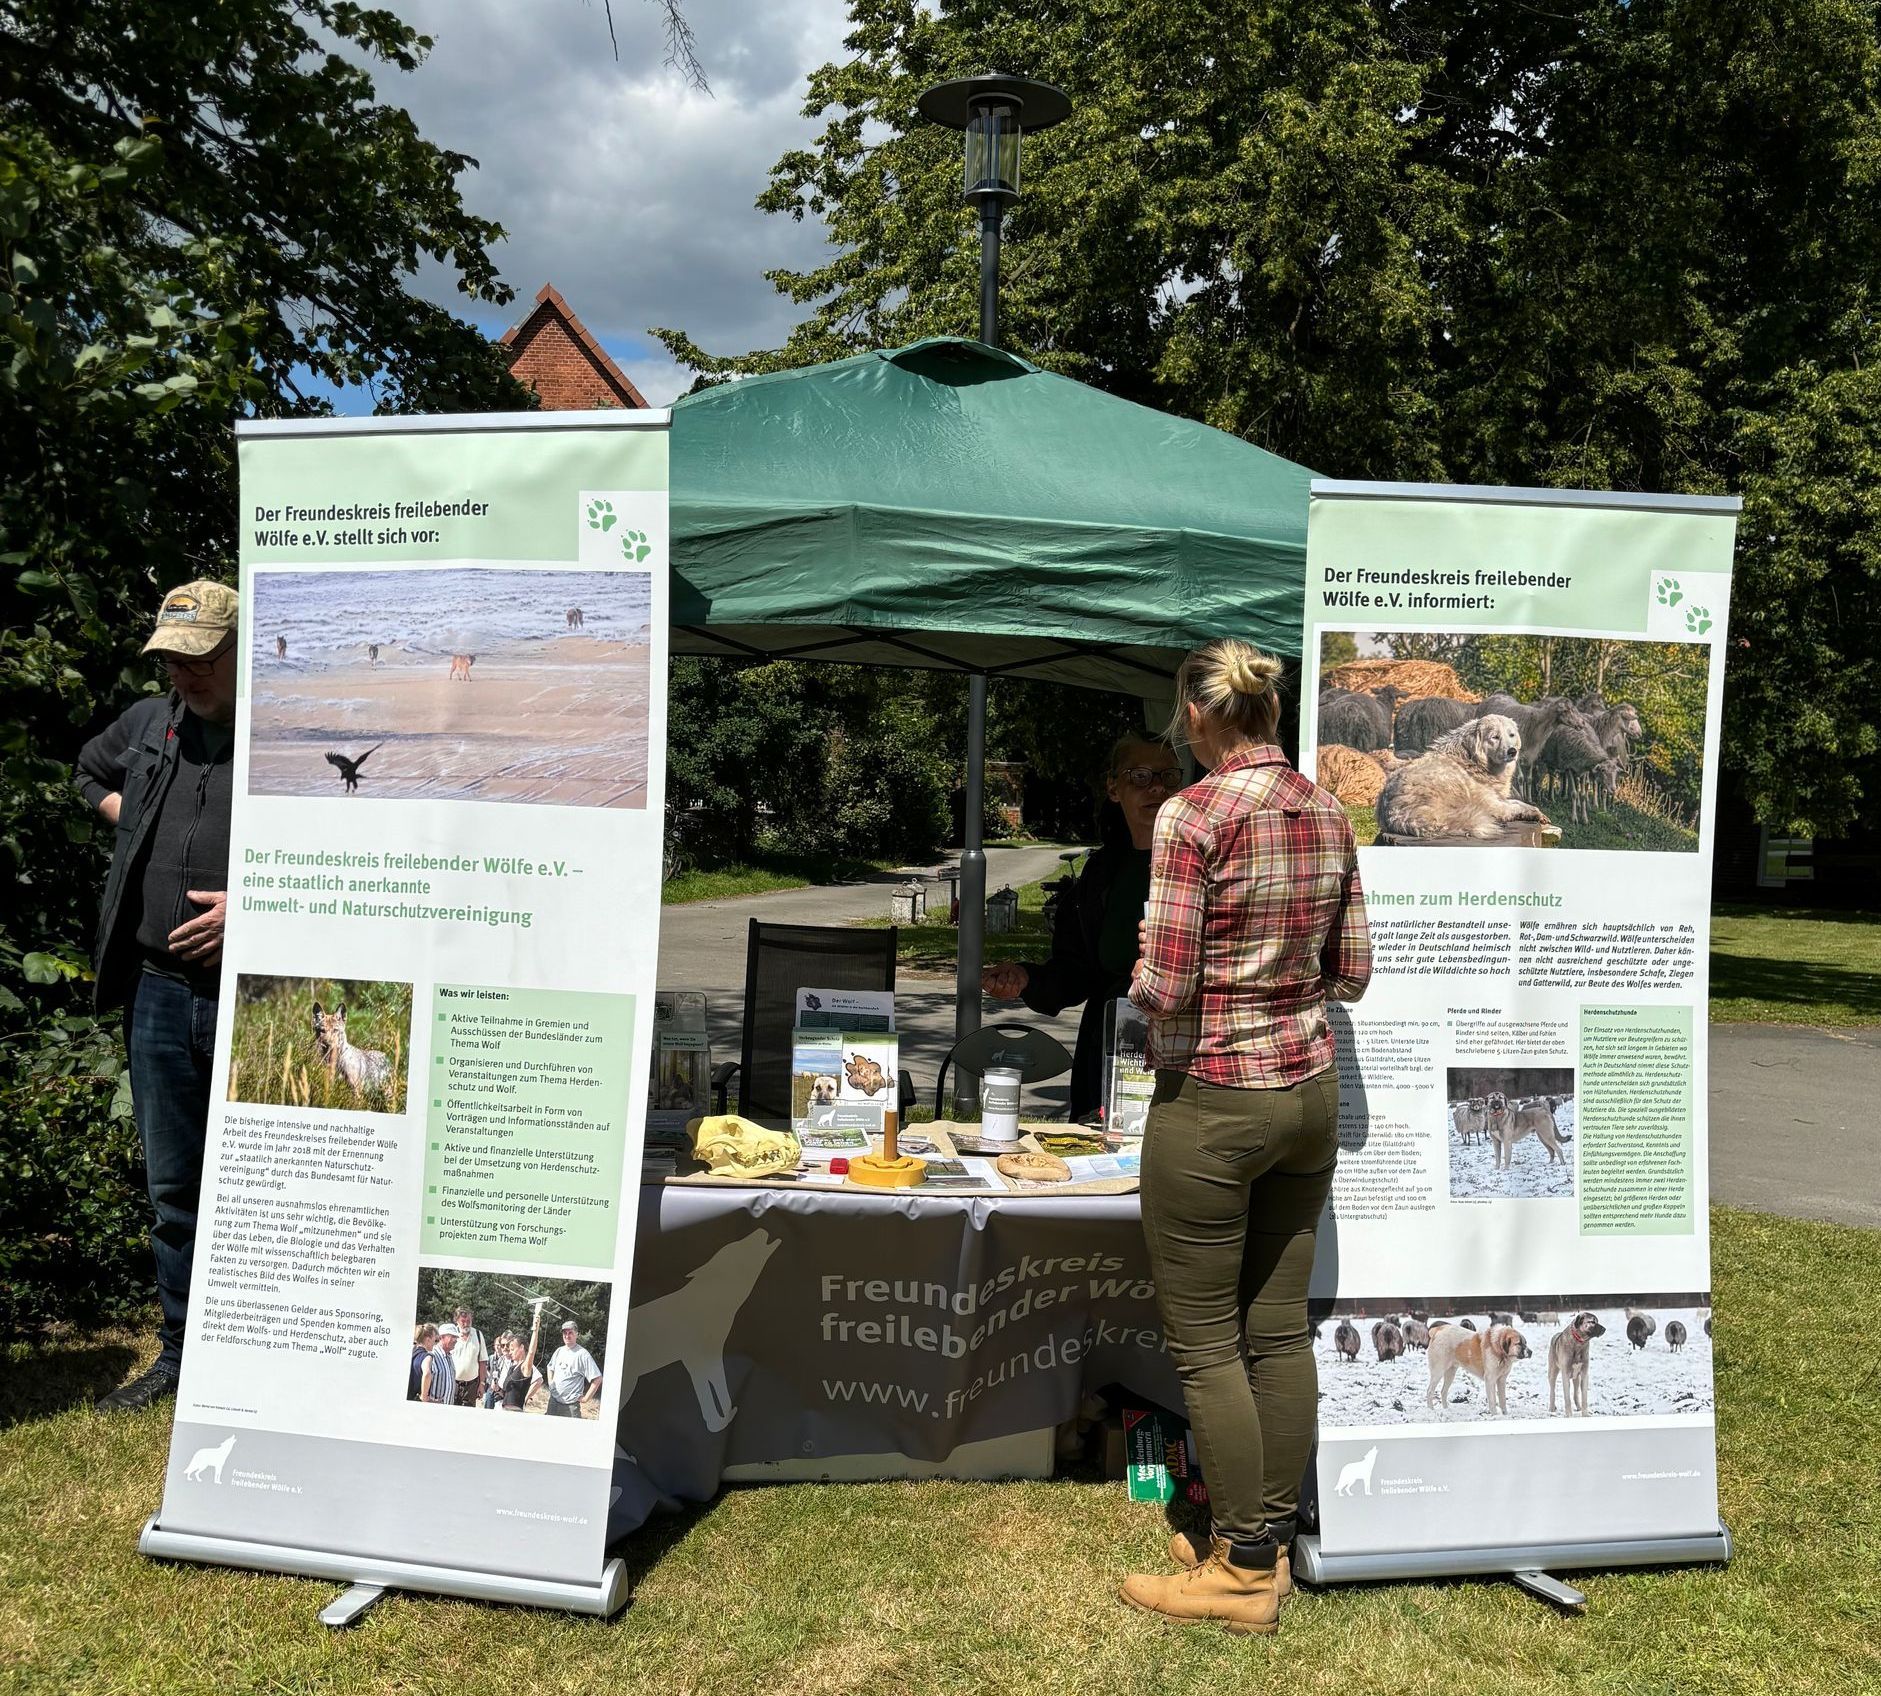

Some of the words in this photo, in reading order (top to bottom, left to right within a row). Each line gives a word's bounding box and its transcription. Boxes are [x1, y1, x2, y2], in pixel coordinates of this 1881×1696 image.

[255, 506, 281, 521] Der
[285, 504, 390, 520] Freundeskreis
[394, 500, 489, 518] freilebender
[254, 530, 298, 546] Wölfe
[302, 530, 329, 545] e.V.
[333, 528, 373, 545] stellt
[376, 527, 406, 544] sich
[410, 530, 439, 542] vor:
[1324, 567, 1352, 582] Der
[1356, 568, 1470, 584] Freundeskreis
[1474, 570, 1571, 587] freilebender
[1322, 591, 1370, 606] Wölfe
[1373, 592, 1402, 607] e.V.
[1408, 592, 1494, 608] informiert:
[244, 848, 271, 863] Der
[274, 850, 379, 867] Freundeskreis
[383, 853, 479, 871] freilebender
[483, 857, 533, 874] Wölfe
[537, 861, 568, 876] e.V.
[242, 872, 274, 887] eine
[278, 874, 343, 890] staatlich
[348, 878, 430, 893] anerkannte
[1364, 891, 1415, 906] ahmen
[1419, 894, 1452, 905] zum
[1458, 891, 1562, 906] Herdenschutz
[242, 896, 304, 912] Umwelt-
[308, 899, 337, 914] und
[342, 901, 533, 926] Naturschutzvereinigung
[1366, 919, 1389, 930] einst
[1390, 920, 1436, 928] natürlicher
[1436, 920, 1485, 928] Bestandteil
[1519, 920, 1540, 930] Wölfe
[1543, 922, 1577, 930] ernähren
[1581, 922, 1598, 930] sich
[1602, 923, 1655, 932] hauptsächlich
[1678, 924, 1694, 933] Reh,
[1378, 931, 1394, 941] galt
[1395, 931, 1418, 941] lange
[1419, 931, 1436, 940] Zeit
[1436, 932, 1449, 940] als
[1450, 932, 1511, 941] ausgestorben.
[1378, 943, 1406, 951] wieder
[1407, 943, 1416, 951] in
[1418, 943, 1470, 951] Deutschland
[1471, 943, 1511, 951] heimisch
[1394, 954, 1414, 962] sehr
[1415, 955, 1435, 964] gute
[1438, 955, 1510, 964] Lebensbedingun-
[1518, 978, 1532, 986] und
[1532, 978, 1572, 987] Gatterwild,
[1587, 979, 1610, 987] Beute
[1610, 979, 1625, 987] des
[1626, 980, 1651, 989] Wolfes
[1653, 978, 1682, 988] werden.
[439, 988, 458, 997] Was
[460, 989, 475, 998] wir
[476, 990, 509, 1000] leisten:
[450, 1013, 478, 1023] Aktive
[480, 1015, 523, 1026] Teilnahme
[525, 1017, 533, 1026] in
[535, 1018, 570, 1028] Gremien
[572, 1021, 589, 1030] und
[450, 1026, 506, 1037] Ausschüssen
[508, 1029, 523, 1038] der
[524, 1030, 583, 1041] Bundesländer
[584, 1035, 602, 1043] zum
[450, 1038, 479, 1048] Thema
[481, 1040, 501, 1049] Wolf
[449, 1057, 503, 1067] Organisieren
[505, 1060, 522, 1069] und
[523, 1061, 575, 1072] Durchführen
[448, 1069, 518, 1082] Veranstaltungen
[539, 1074, 567, 1084] Thema
[569, 1076, 602, 1086] Herden-
[447, 1082, 476, 1091] schutz
[477, 1084, 494, 1092] und
[495, 1084, 517, 1093] Wolf.
[446, 1099, 532, 1113] Öffentlichkeitsarbeit
[534, 1105, 542, 1114] in
[544, 1105, 565, 1115] Form
[224, 1115, 237, 1124] Die
[239, 1116, 275, 1128] bisherige
[276, 1120, 311, 1129] intensive
[312, 1123, 328, 1131] und
[329, 1124, 375, 1136] nachhaltige
[446, 1112, 487, 1124] Vorträgen
[489, 1115, 506, 1124] und
[507, 1116, 594, 1129] Informationsständen
[595, 1122, 610, 1130] auf
[222, 1127, 246, 1137] Arbeit
[248, 1129, 262, 1138] des
[264, 1130, 326, 1143] Freundeskreises
[328, 1135, 375, 1146] freilebender
[376, 1139, 398, 1149] Wölfe
[445, 1125, 513, 1138] Veranstaltungen
[221, 1140, 236, 1148] e.V.
[237, 1142, 262, 1150] wurde
[263, 1142, 273, 1151] im
[274, 1144, 291, 1152] Jahr
[292, 1146, 311, 1154] 2018
[312, 1146, 325, 1155] mit
[326, 1148, 341, 1156] der
[342, 1149, 384, 1162] Ernennung
[821, 1253, 1126, 1316] Freundeskreis
[820, 1284, 1078, 1359] freilebender
[1089, 1278, 1157, 1300] Wö
[200, 1333, 215, 1341] der
[216, 1334, 271, 1349] Feldforschung
[272, 1341, 289, 1349] zum
[291, 1341, 318, 1352] Thema
[319, 1345, 347, 1354] „Wolf“
[347, 1349, 378, 1358] zugute.
[821, 1319, 1168, 1420] www.freundeskrei
[1164, 1440, 1180, 1479] ADAC
